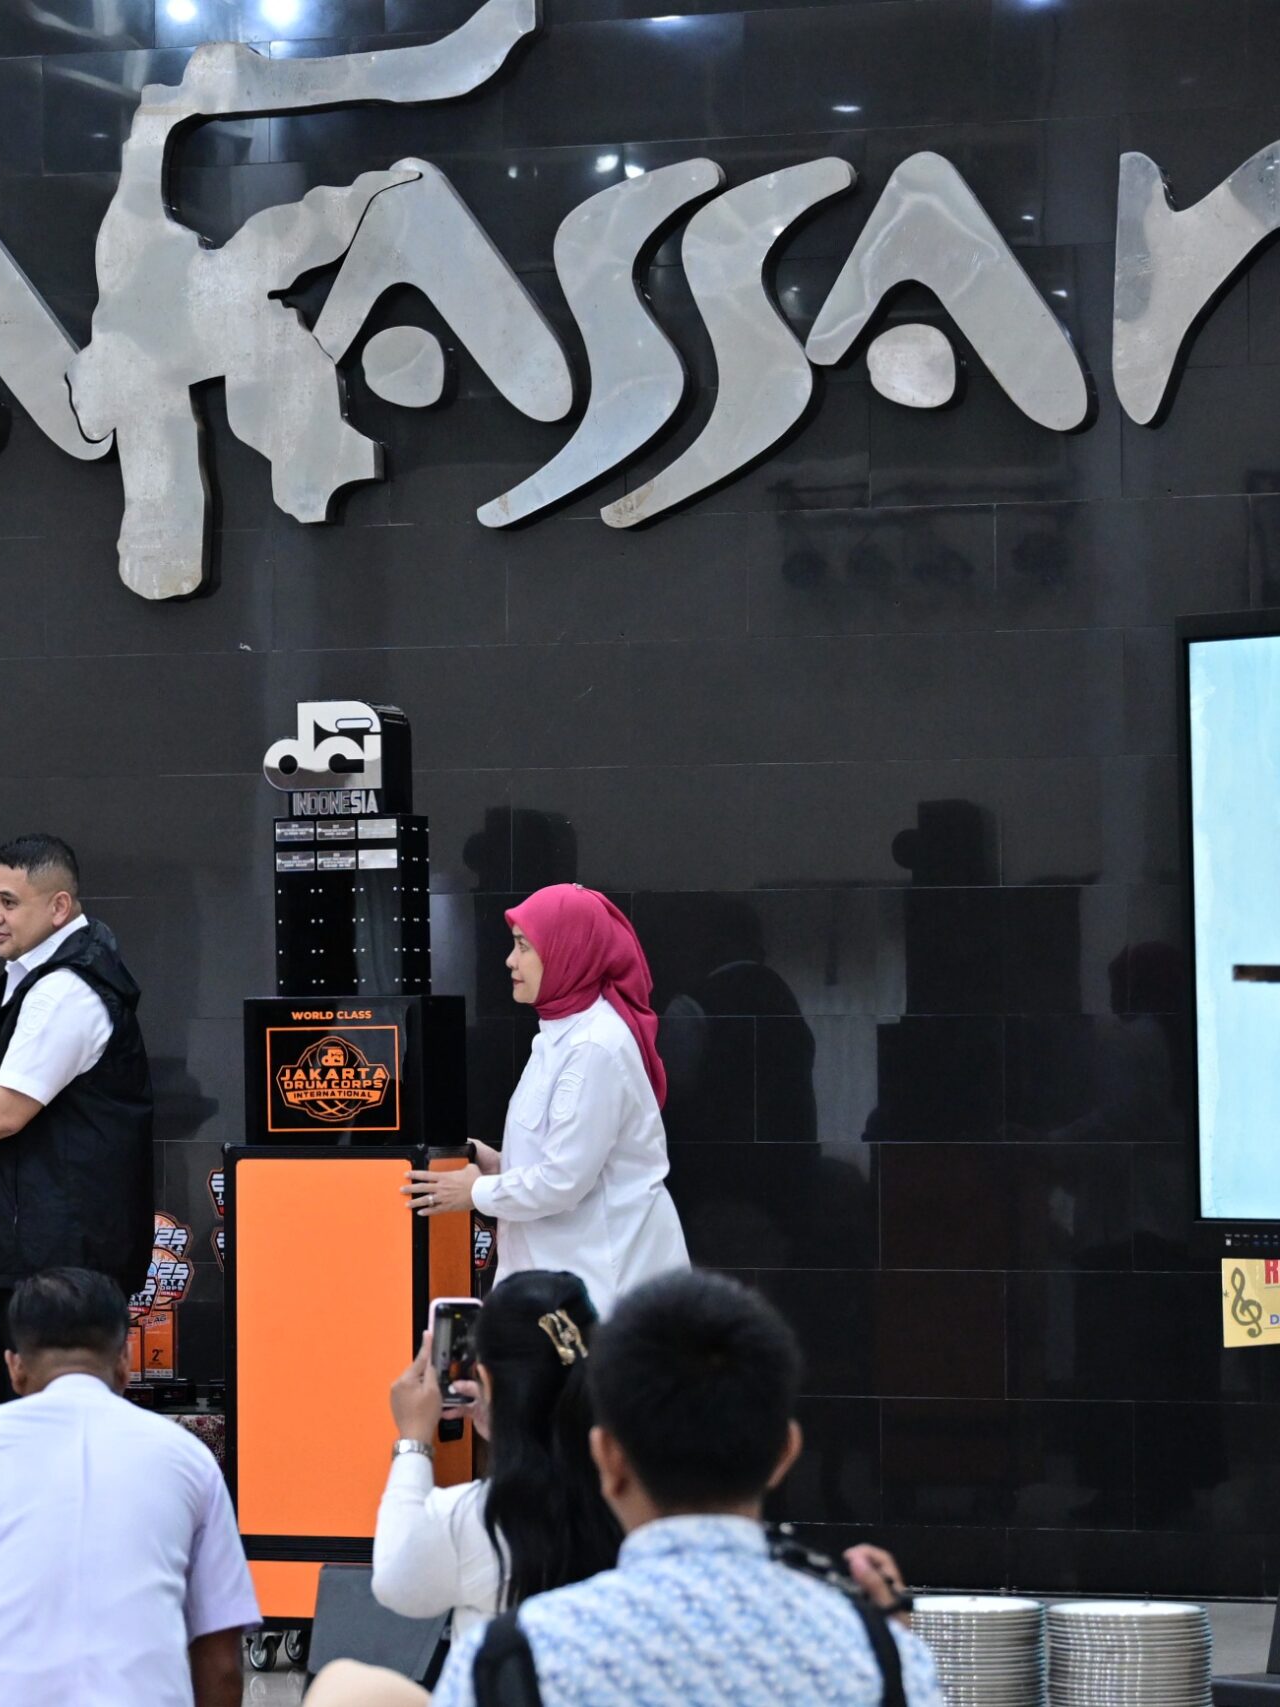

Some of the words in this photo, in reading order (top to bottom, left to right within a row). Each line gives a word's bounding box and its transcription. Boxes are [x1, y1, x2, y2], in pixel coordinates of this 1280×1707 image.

[292, 791, 379, 816] INDONESIA
[291, 1011, 334, 1021] WORLD
[336, 1010, 373, 1020] CLASS
[280, 1067, 387, 1081] JAKARTA
[283, 1080, 328, 1090] DRUM
[331, 1079, 384, 1089] CORPS
[293, 1090, 373, 1099] INTERNATIONAL
